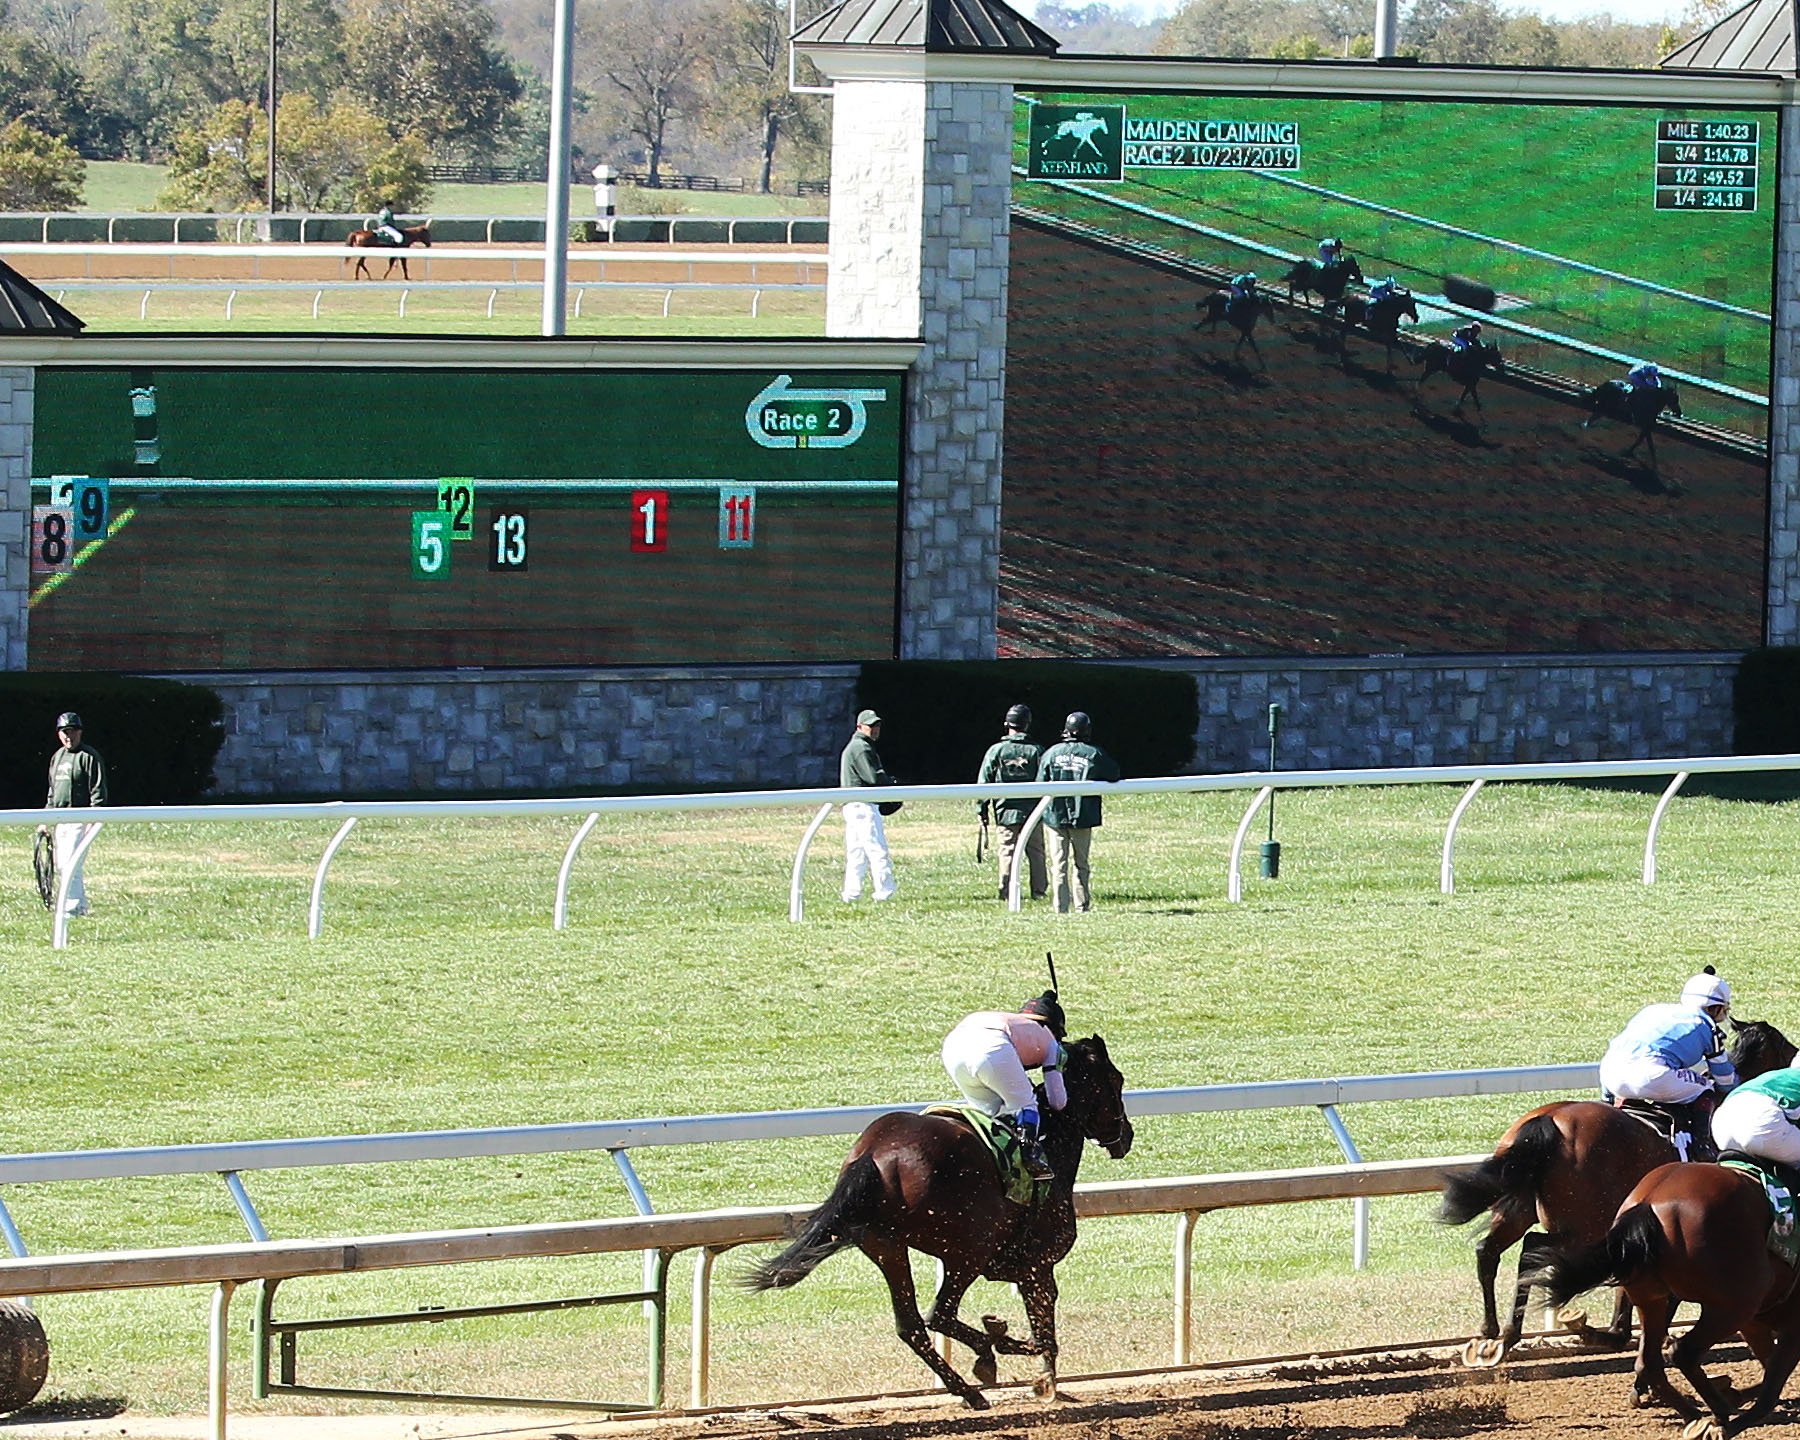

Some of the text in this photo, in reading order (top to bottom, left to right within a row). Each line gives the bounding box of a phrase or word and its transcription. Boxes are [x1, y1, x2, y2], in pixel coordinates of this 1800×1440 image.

[1127, 121, 1293, 142] MAIDEN CLAIMING
[1667, 123, 1749, 139] MILE 1:40.23
[1191, 146, 1294, 167] 10/23/2019
[1675, 145, 1749, 162] 3/4 1:14.78
[1676, 168, 1744, 185] 1/2 :49.52
[1674, 190, 1743, 207] 1/4 :24.18
[764, 408, 840, 430] Race 2
[82, 487, 104, 533] 9
[441, 487, 470, 531] 12
[639, 498, 655, 544] 1
[724, 495, 750, 541] 11
[42, 513, 66, 564] 8
[419, 522, 443, 573] 5
[493, 514, 524, 565] 13
